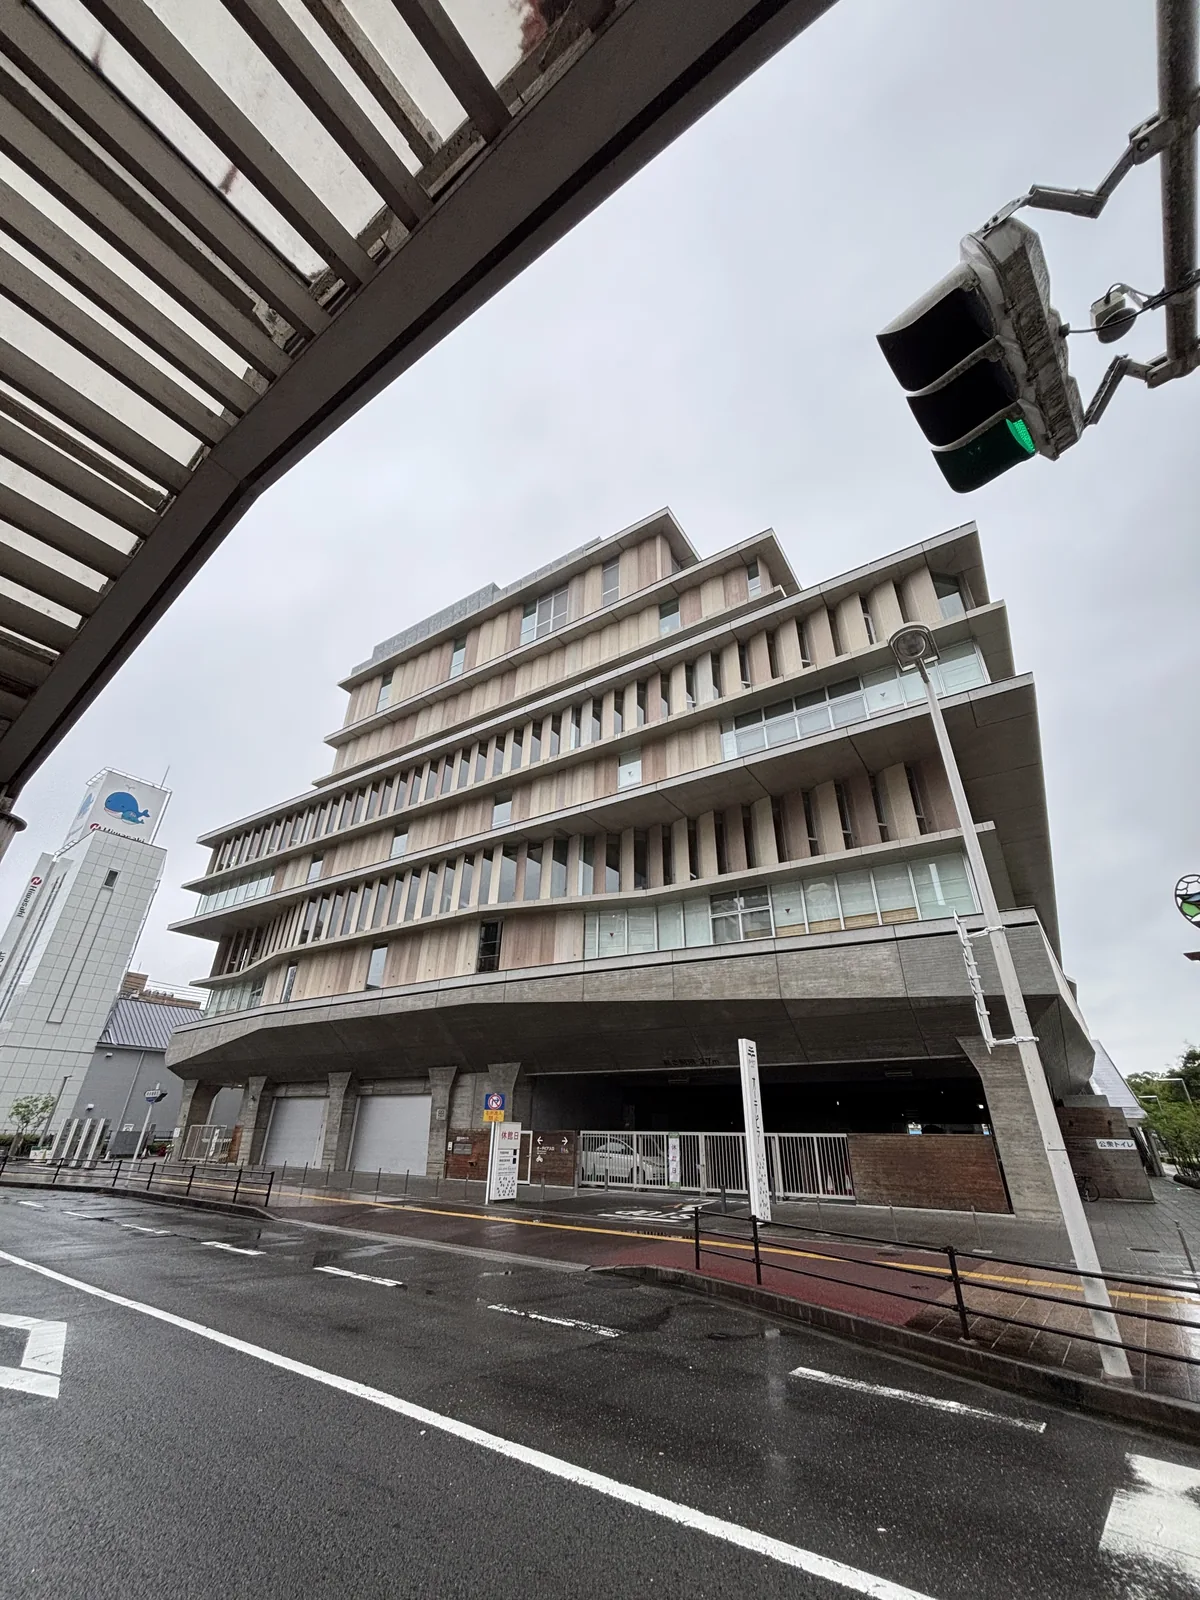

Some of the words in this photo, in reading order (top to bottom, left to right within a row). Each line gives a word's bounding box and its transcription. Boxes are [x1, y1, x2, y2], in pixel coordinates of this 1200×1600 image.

[16, 885, 38, 918] Hiwasaki
[1099, 1140, 1134, 1148] 公衆トイレ
